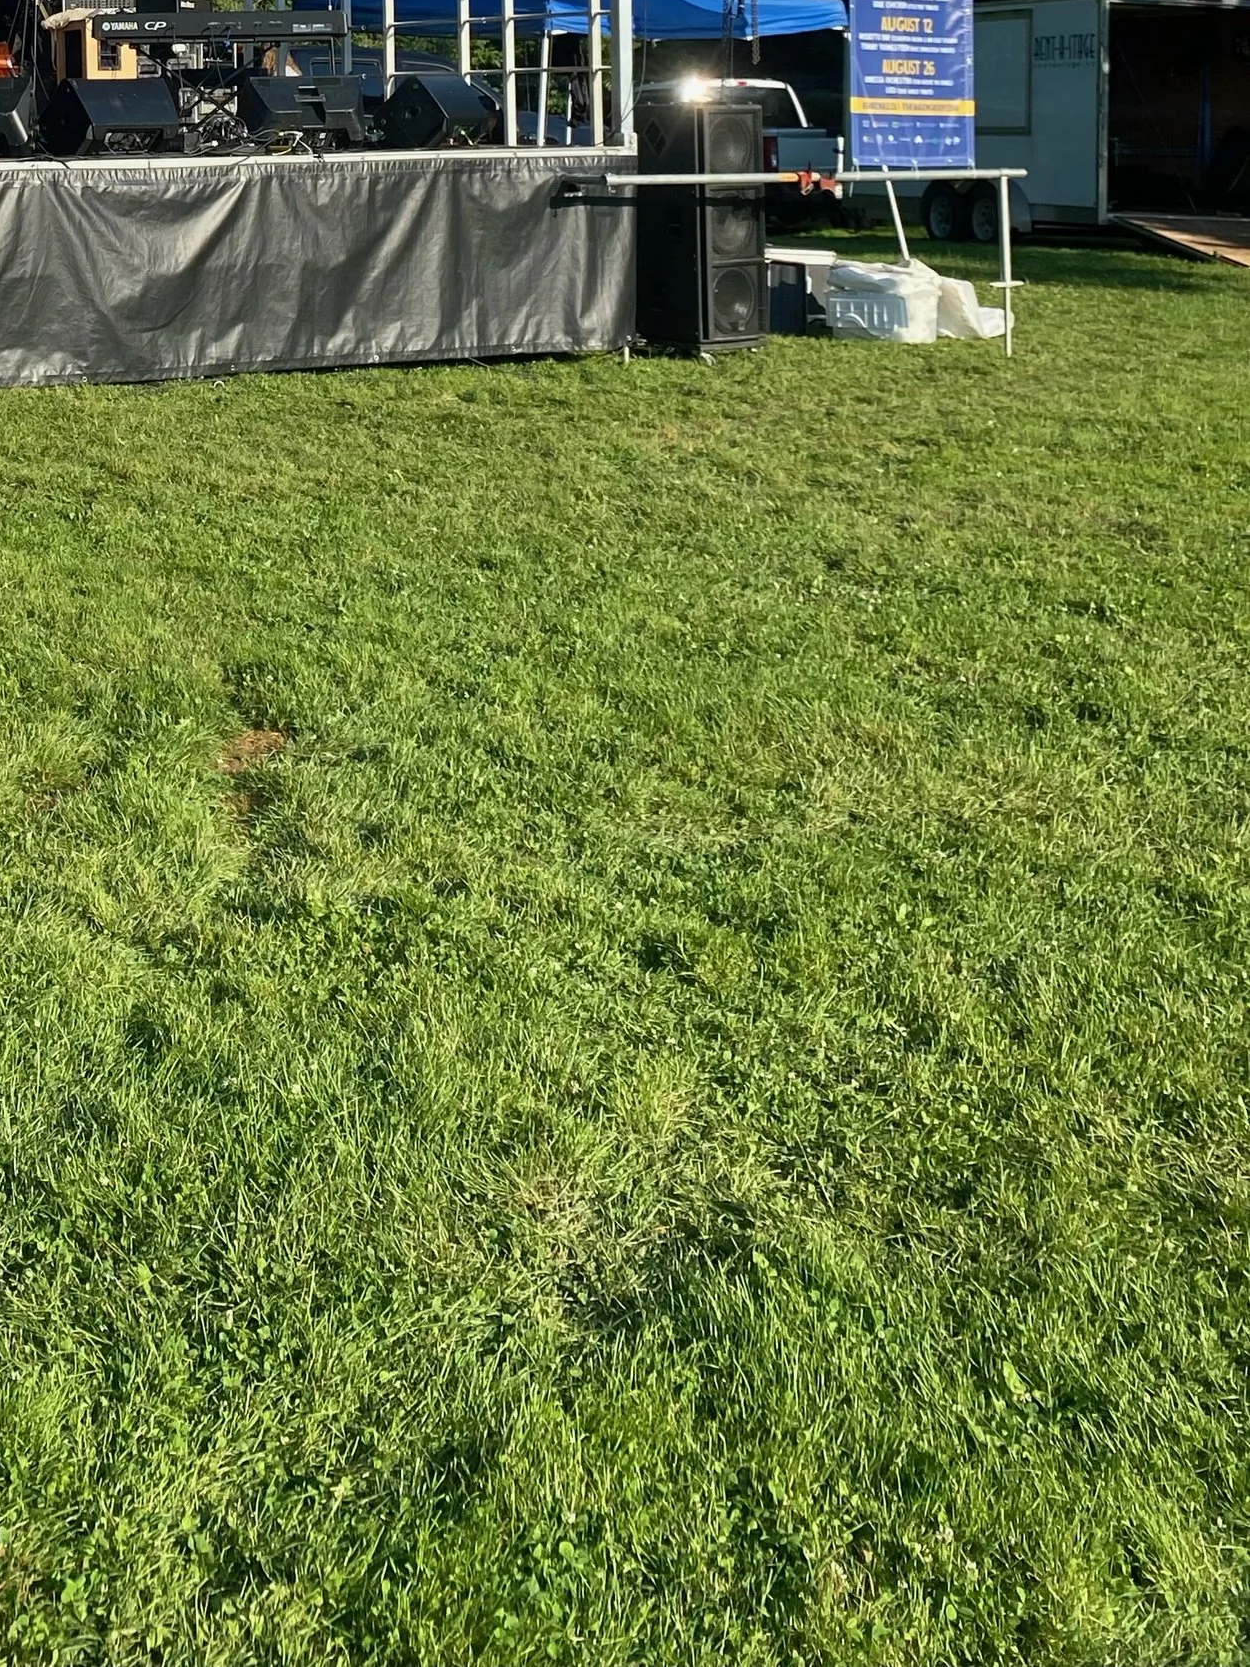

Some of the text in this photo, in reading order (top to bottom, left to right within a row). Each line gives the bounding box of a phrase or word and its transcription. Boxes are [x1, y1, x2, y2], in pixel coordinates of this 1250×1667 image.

[111, 21, 167, 31] YAMAHA CP
[881, 16, 933, 34] AUGUST 12
[882, 59, 935, 76] AUGUST 26
